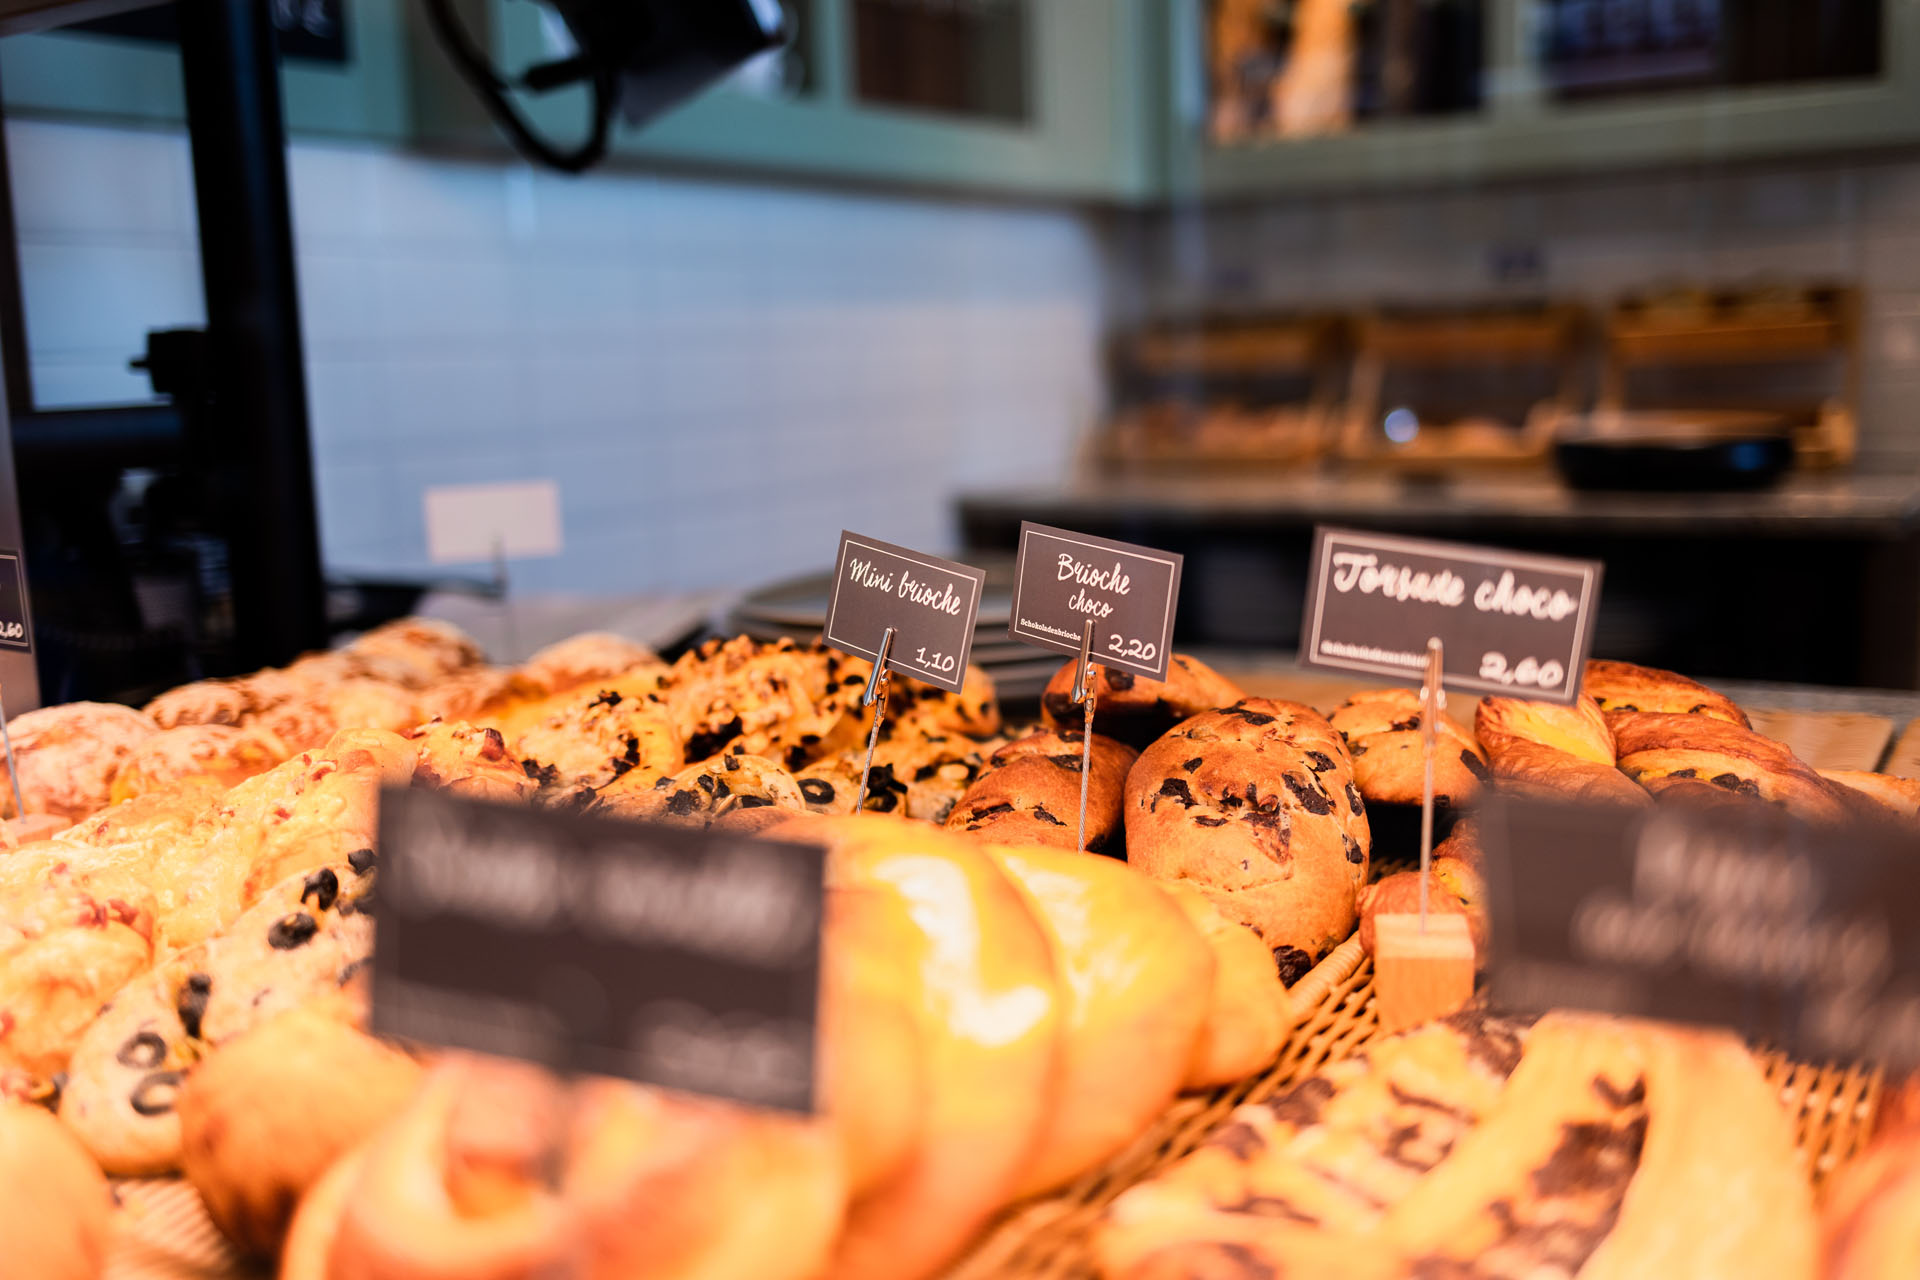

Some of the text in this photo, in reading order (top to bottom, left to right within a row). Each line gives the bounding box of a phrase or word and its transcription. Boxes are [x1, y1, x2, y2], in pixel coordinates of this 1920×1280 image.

[849, 558, 961, 616] Mini brioche
[1057, 552, 1130, 595] Brioche
[1068, 588, 1114, 618] choco
[1474, 569, 1579, 621] choco
[1020, 618, 1081, 642] Schokoladenbrioche
[915, 646, 955, 672] 1,10
[1108, 633, 1156, 661] 2,20
[1479, 651, 1564, 688] 2,60
